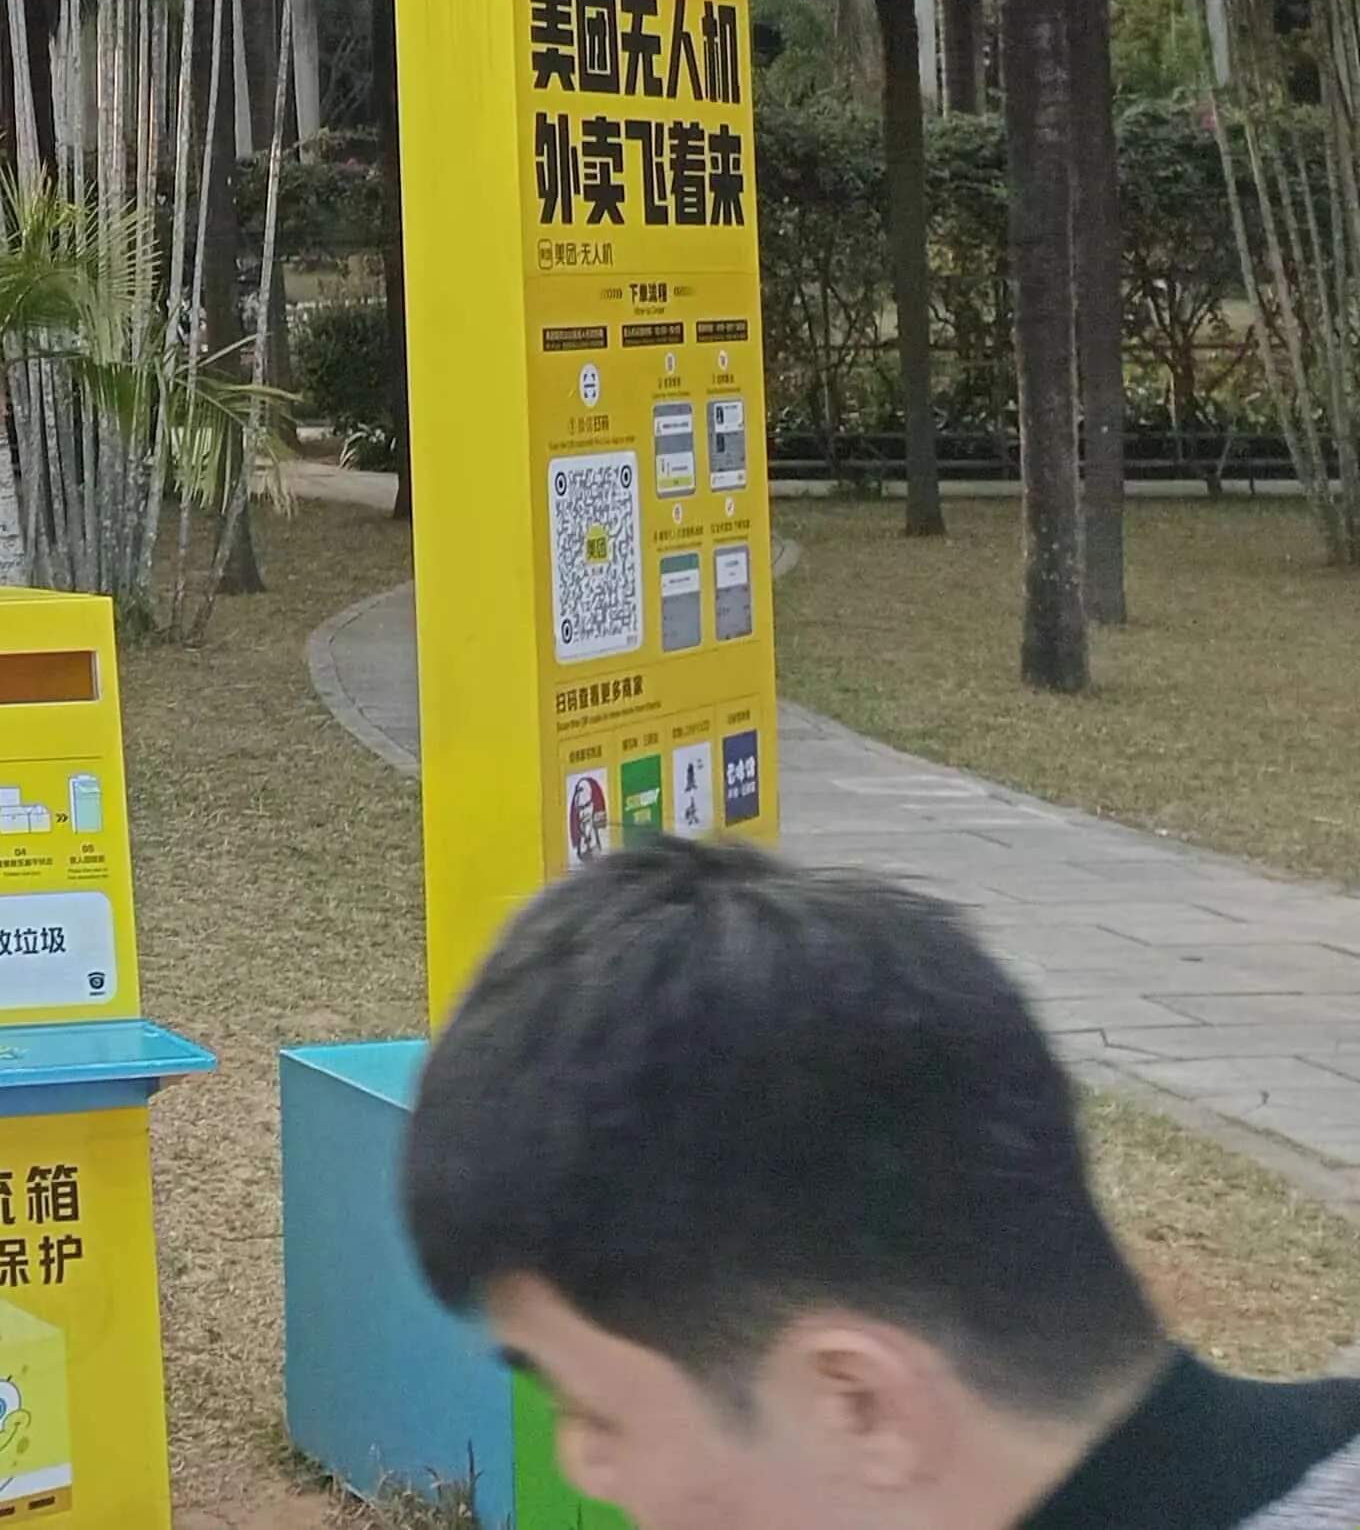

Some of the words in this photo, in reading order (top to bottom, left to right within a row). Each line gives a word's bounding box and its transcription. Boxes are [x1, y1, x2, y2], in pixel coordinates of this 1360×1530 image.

[534, 112, 745, 226] 外卖飞着来
[556, 674, 643, 713] 扫码查看更多商家
